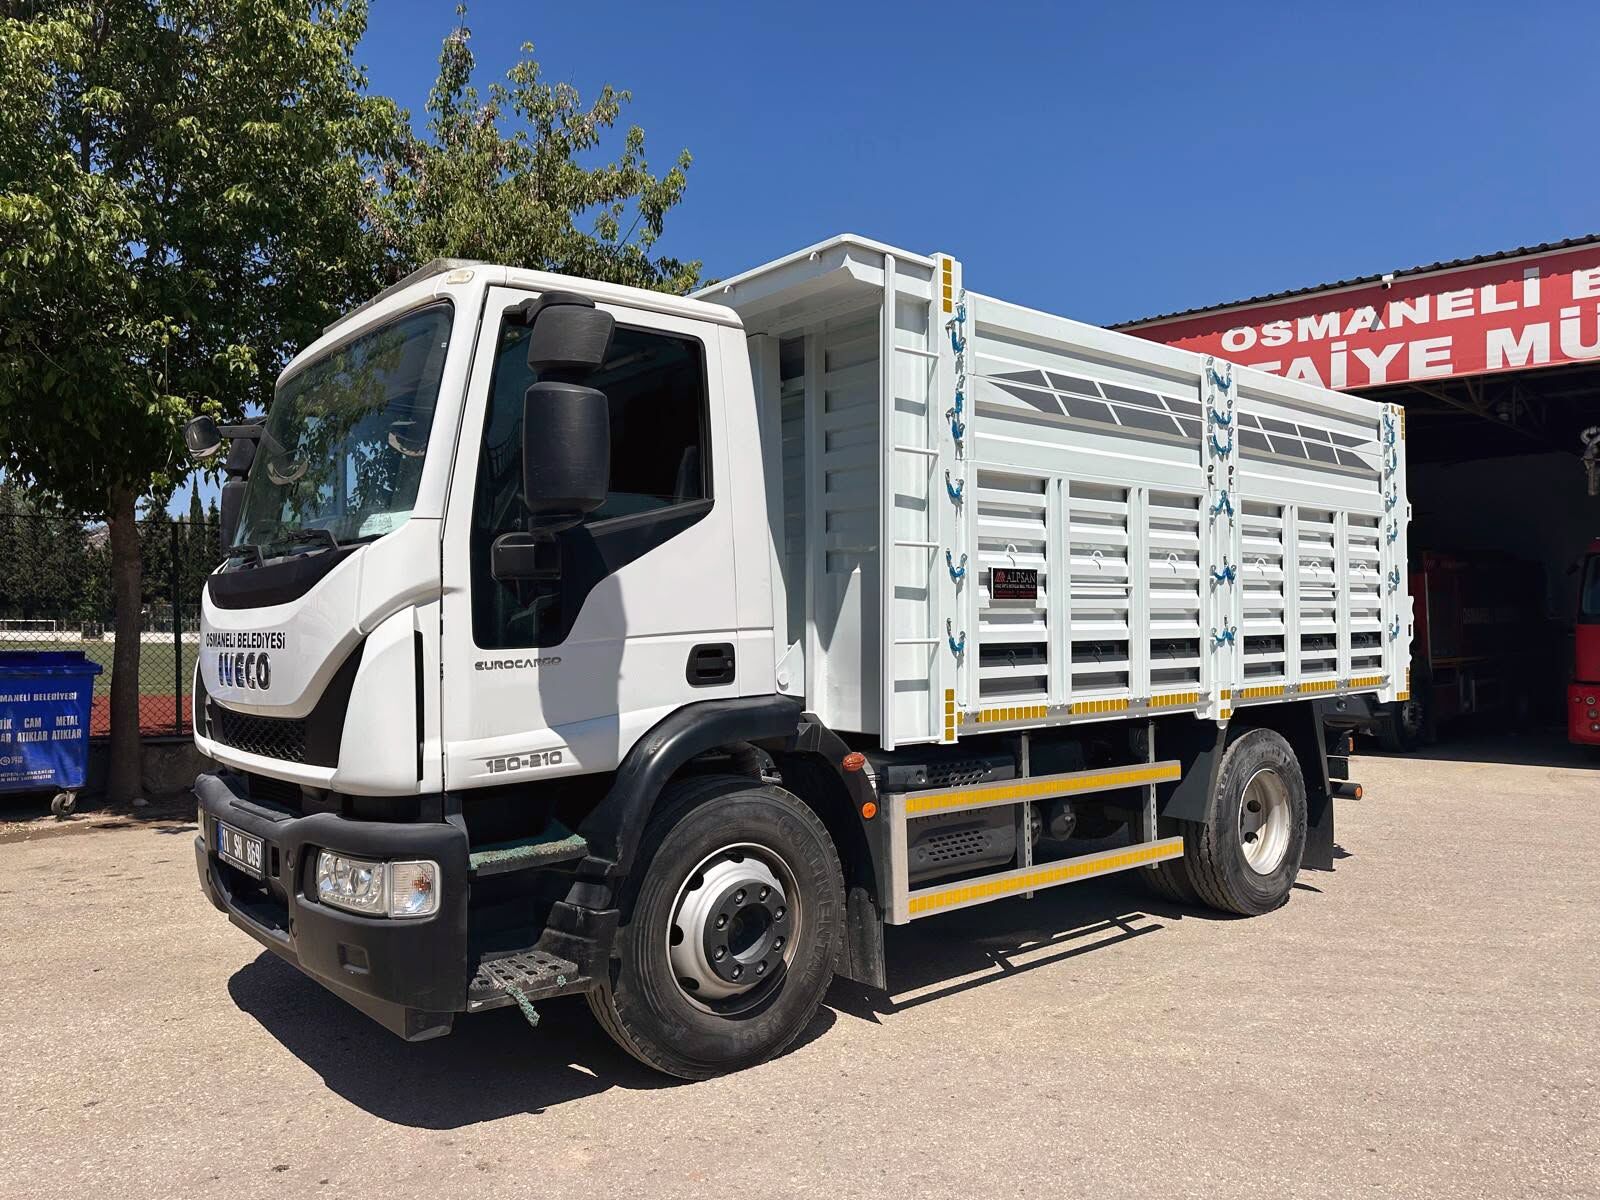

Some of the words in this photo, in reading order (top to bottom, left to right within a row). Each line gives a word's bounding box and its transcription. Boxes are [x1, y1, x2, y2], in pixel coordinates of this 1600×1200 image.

[1221, 266, 1540, 352] OSMANELİ
[1007, 571, 1036, 584] ALPSAN
[206, 632, 236, 648] OSMANELİ
[237, 632, 286, 649] BELEDİYESİ
[475, 656, 562, 671] EUROCARGO
[218, 652, 271, 690] IVECO
[33, 692, 77, 701] BELEDİYESİ
[24, 717, 42, 729] CAM
[56, 715, 79, 727] METAL
[17, 730, 48, 742] ATIKLAR
[52, 728, 82, 740] ATIKLAR
